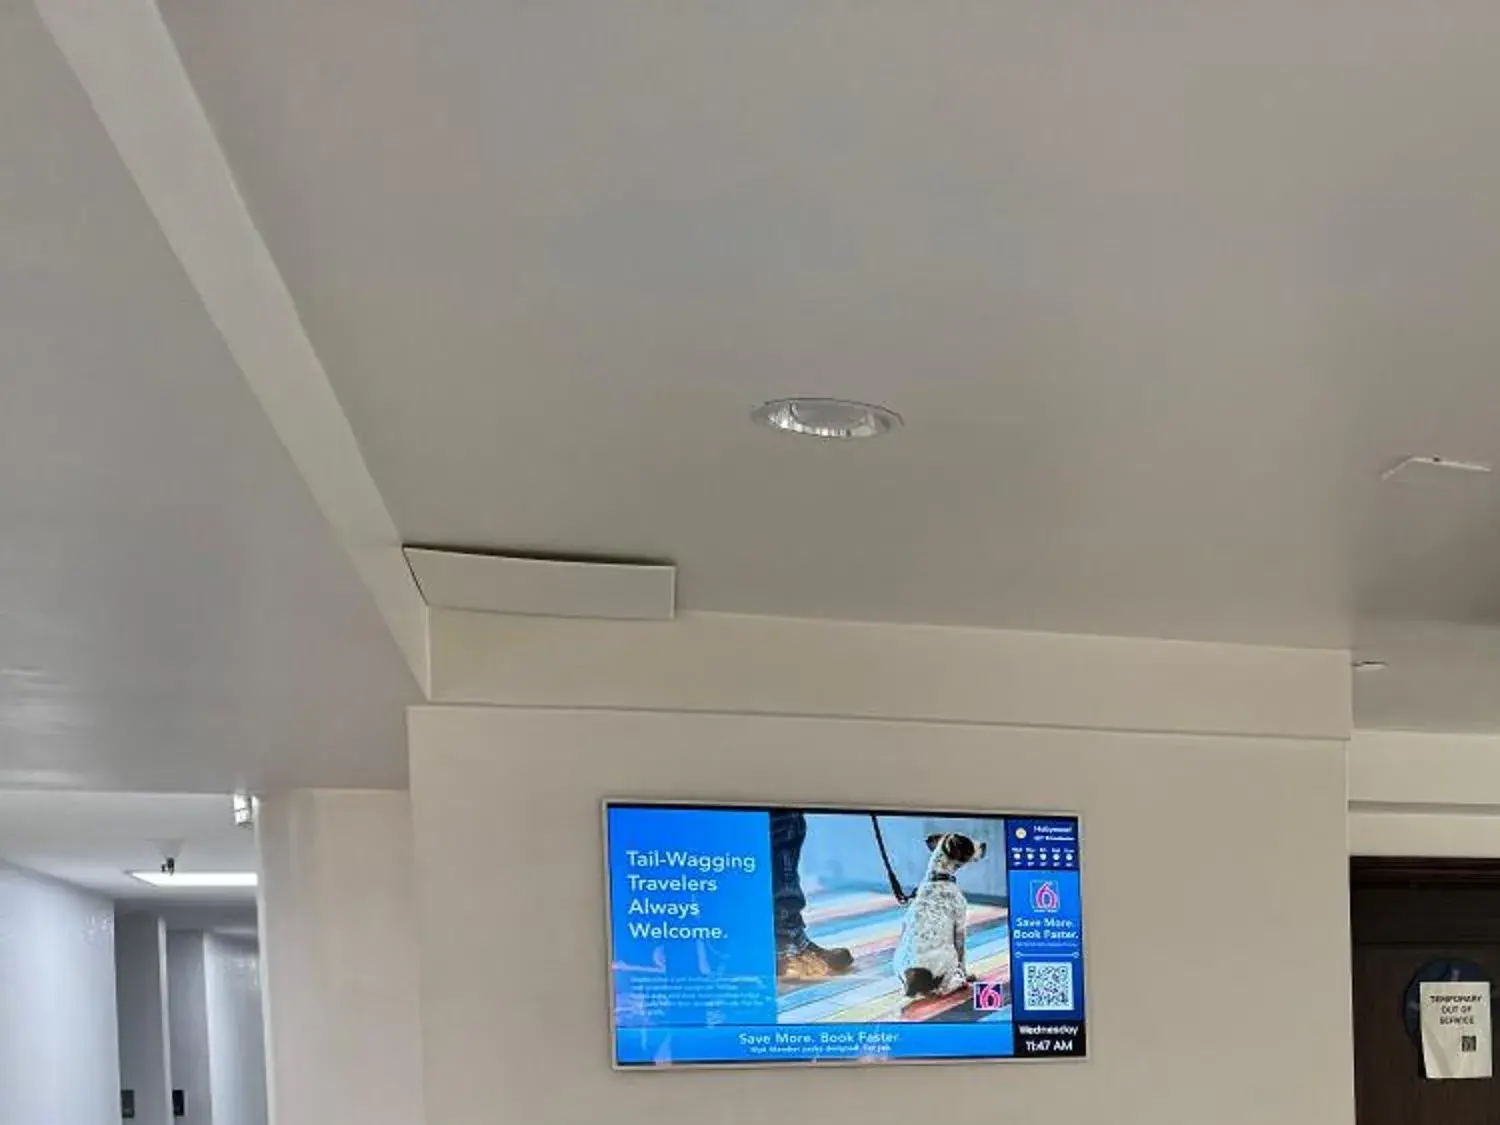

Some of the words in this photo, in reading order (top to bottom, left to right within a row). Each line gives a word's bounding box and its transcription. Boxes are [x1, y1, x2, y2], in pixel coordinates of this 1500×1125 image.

[626, 850, 755, 872] Tail-Wagging
[626, 874, 718, 891] Travelers
[628, 898, 700, 919] Always
[1015, 917, 1041, 927] Save
[628, 922, 729, 939] Welcome.
[1013, 929, 1041, 939] Book
[1018, 1024, 1079, 1036] Wednesday
[738, 1033, 771, 1045] Save
[775, 1033, 815, 1044] More.
[820, 1032, 855, 1043] Book
[1026, 1040, 1051, 1052] 11:47
[1053, 1040, 1074, 1051] AM
